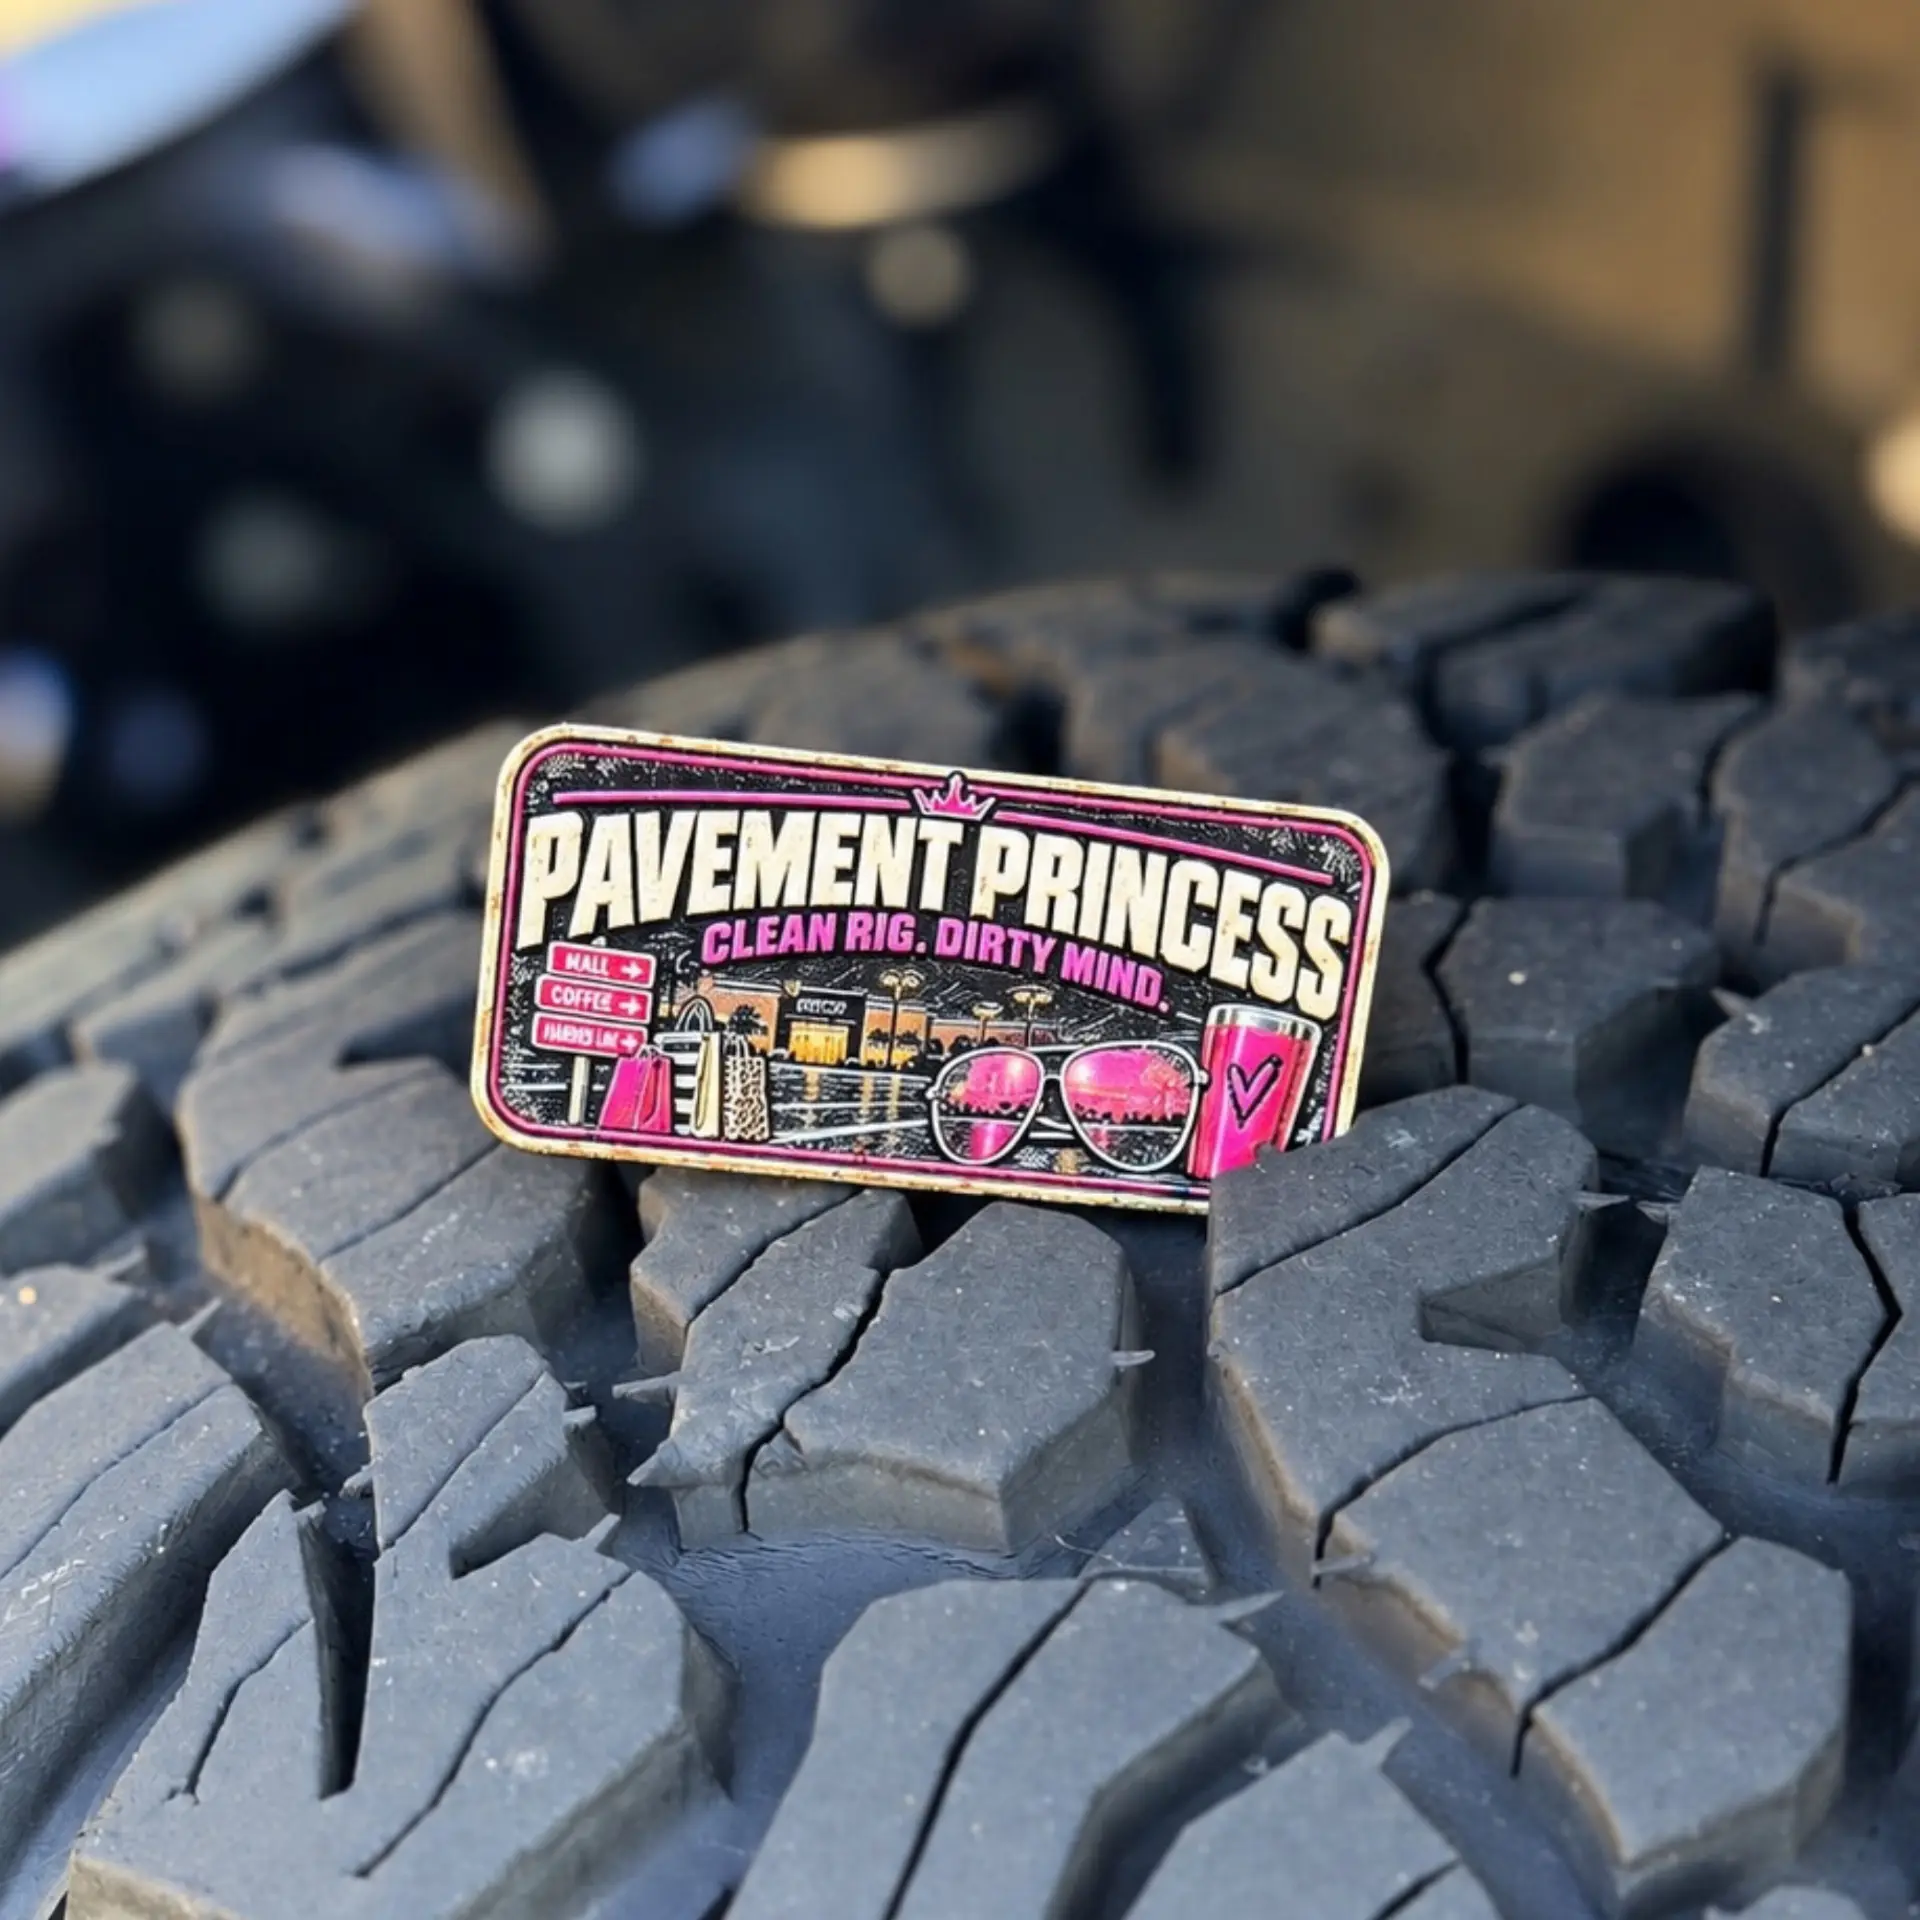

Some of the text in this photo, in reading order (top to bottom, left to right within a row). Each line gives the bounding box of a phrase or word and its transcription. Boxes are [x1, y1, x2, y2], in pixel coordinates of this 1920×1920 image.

[515, 810, 1352, 1021] PAVEMENT PRINCESS
[564, 952, 610, 977] MALL
[701, 911, 1171, 1014] CLEAN RIG. DIRTY MIND.
[550, 984, 613, 1013] COFFEE
